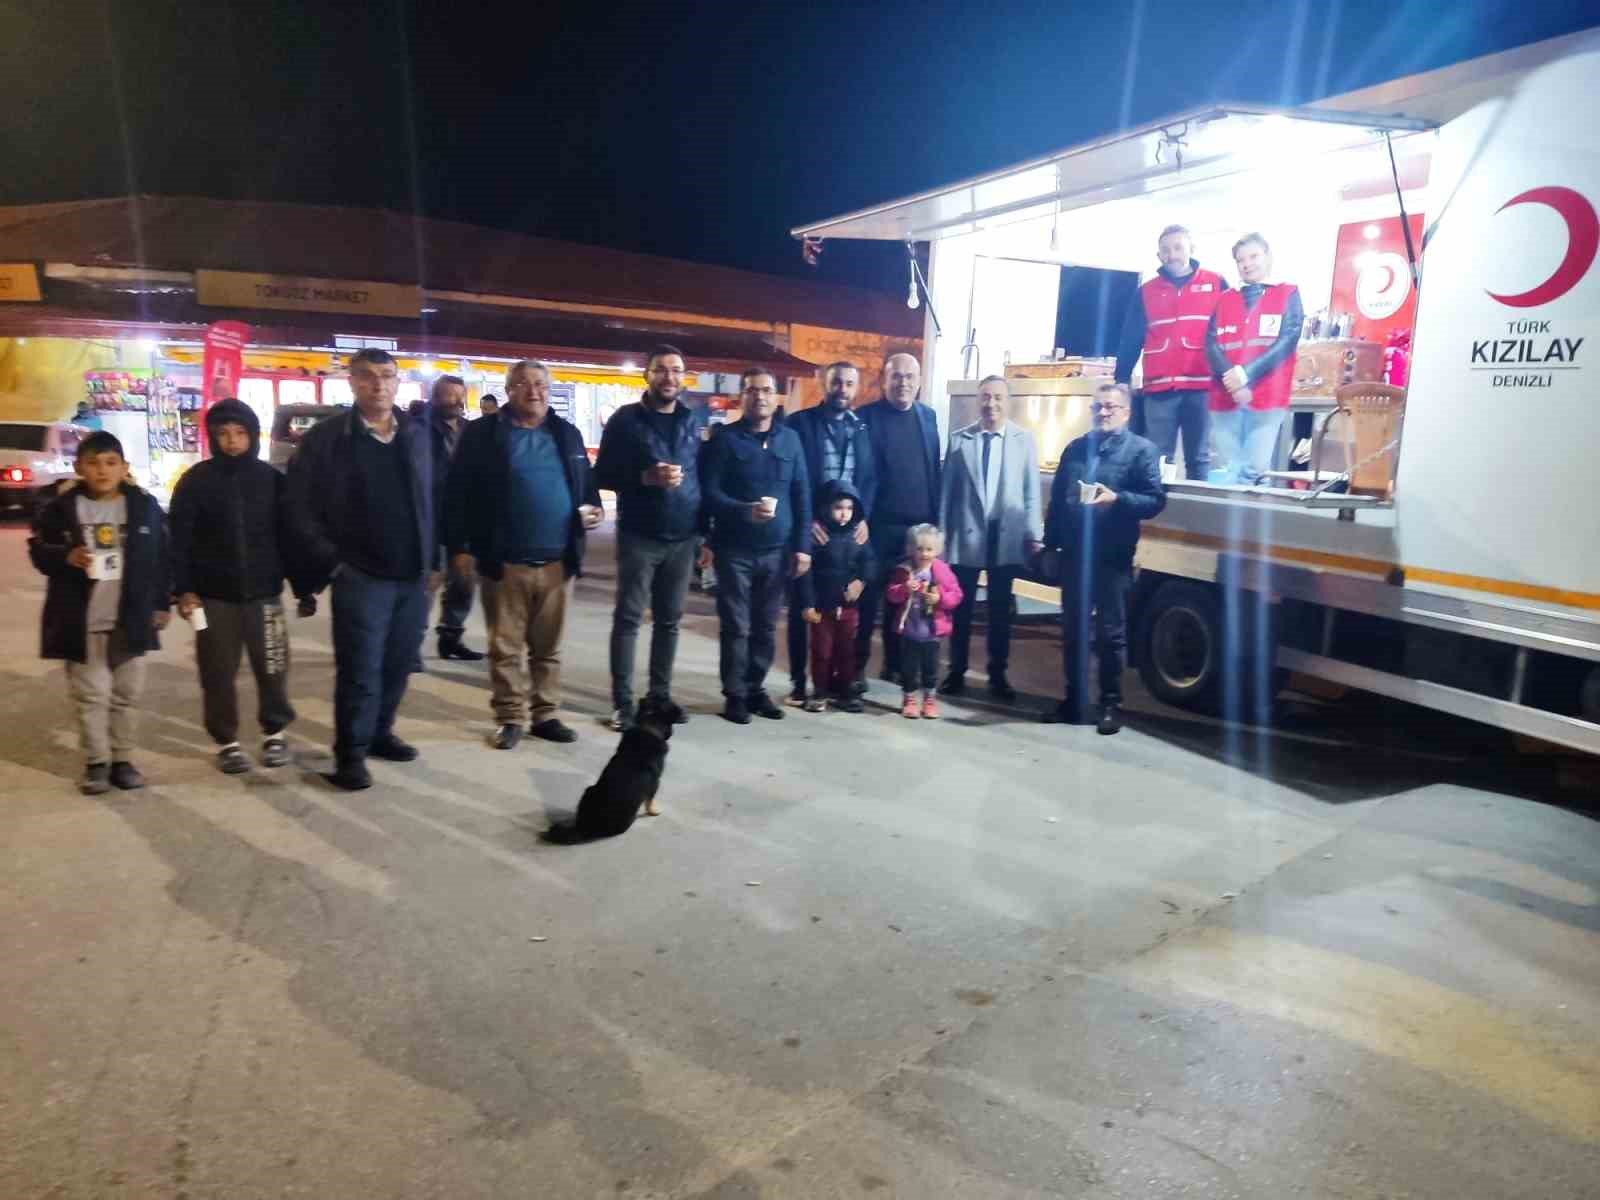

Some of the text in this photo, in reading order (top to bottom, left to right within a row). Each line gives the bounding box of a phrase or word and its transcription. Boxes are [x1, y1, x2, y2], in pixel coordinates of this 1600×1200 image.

[313, 287, 369, 304] MARKET
[1506, 318, 1552, 335] TÜRK
[1470, 337, 1585, 363] KIZILAY
[1492, 372, 1552, 388] DENİZLİ
